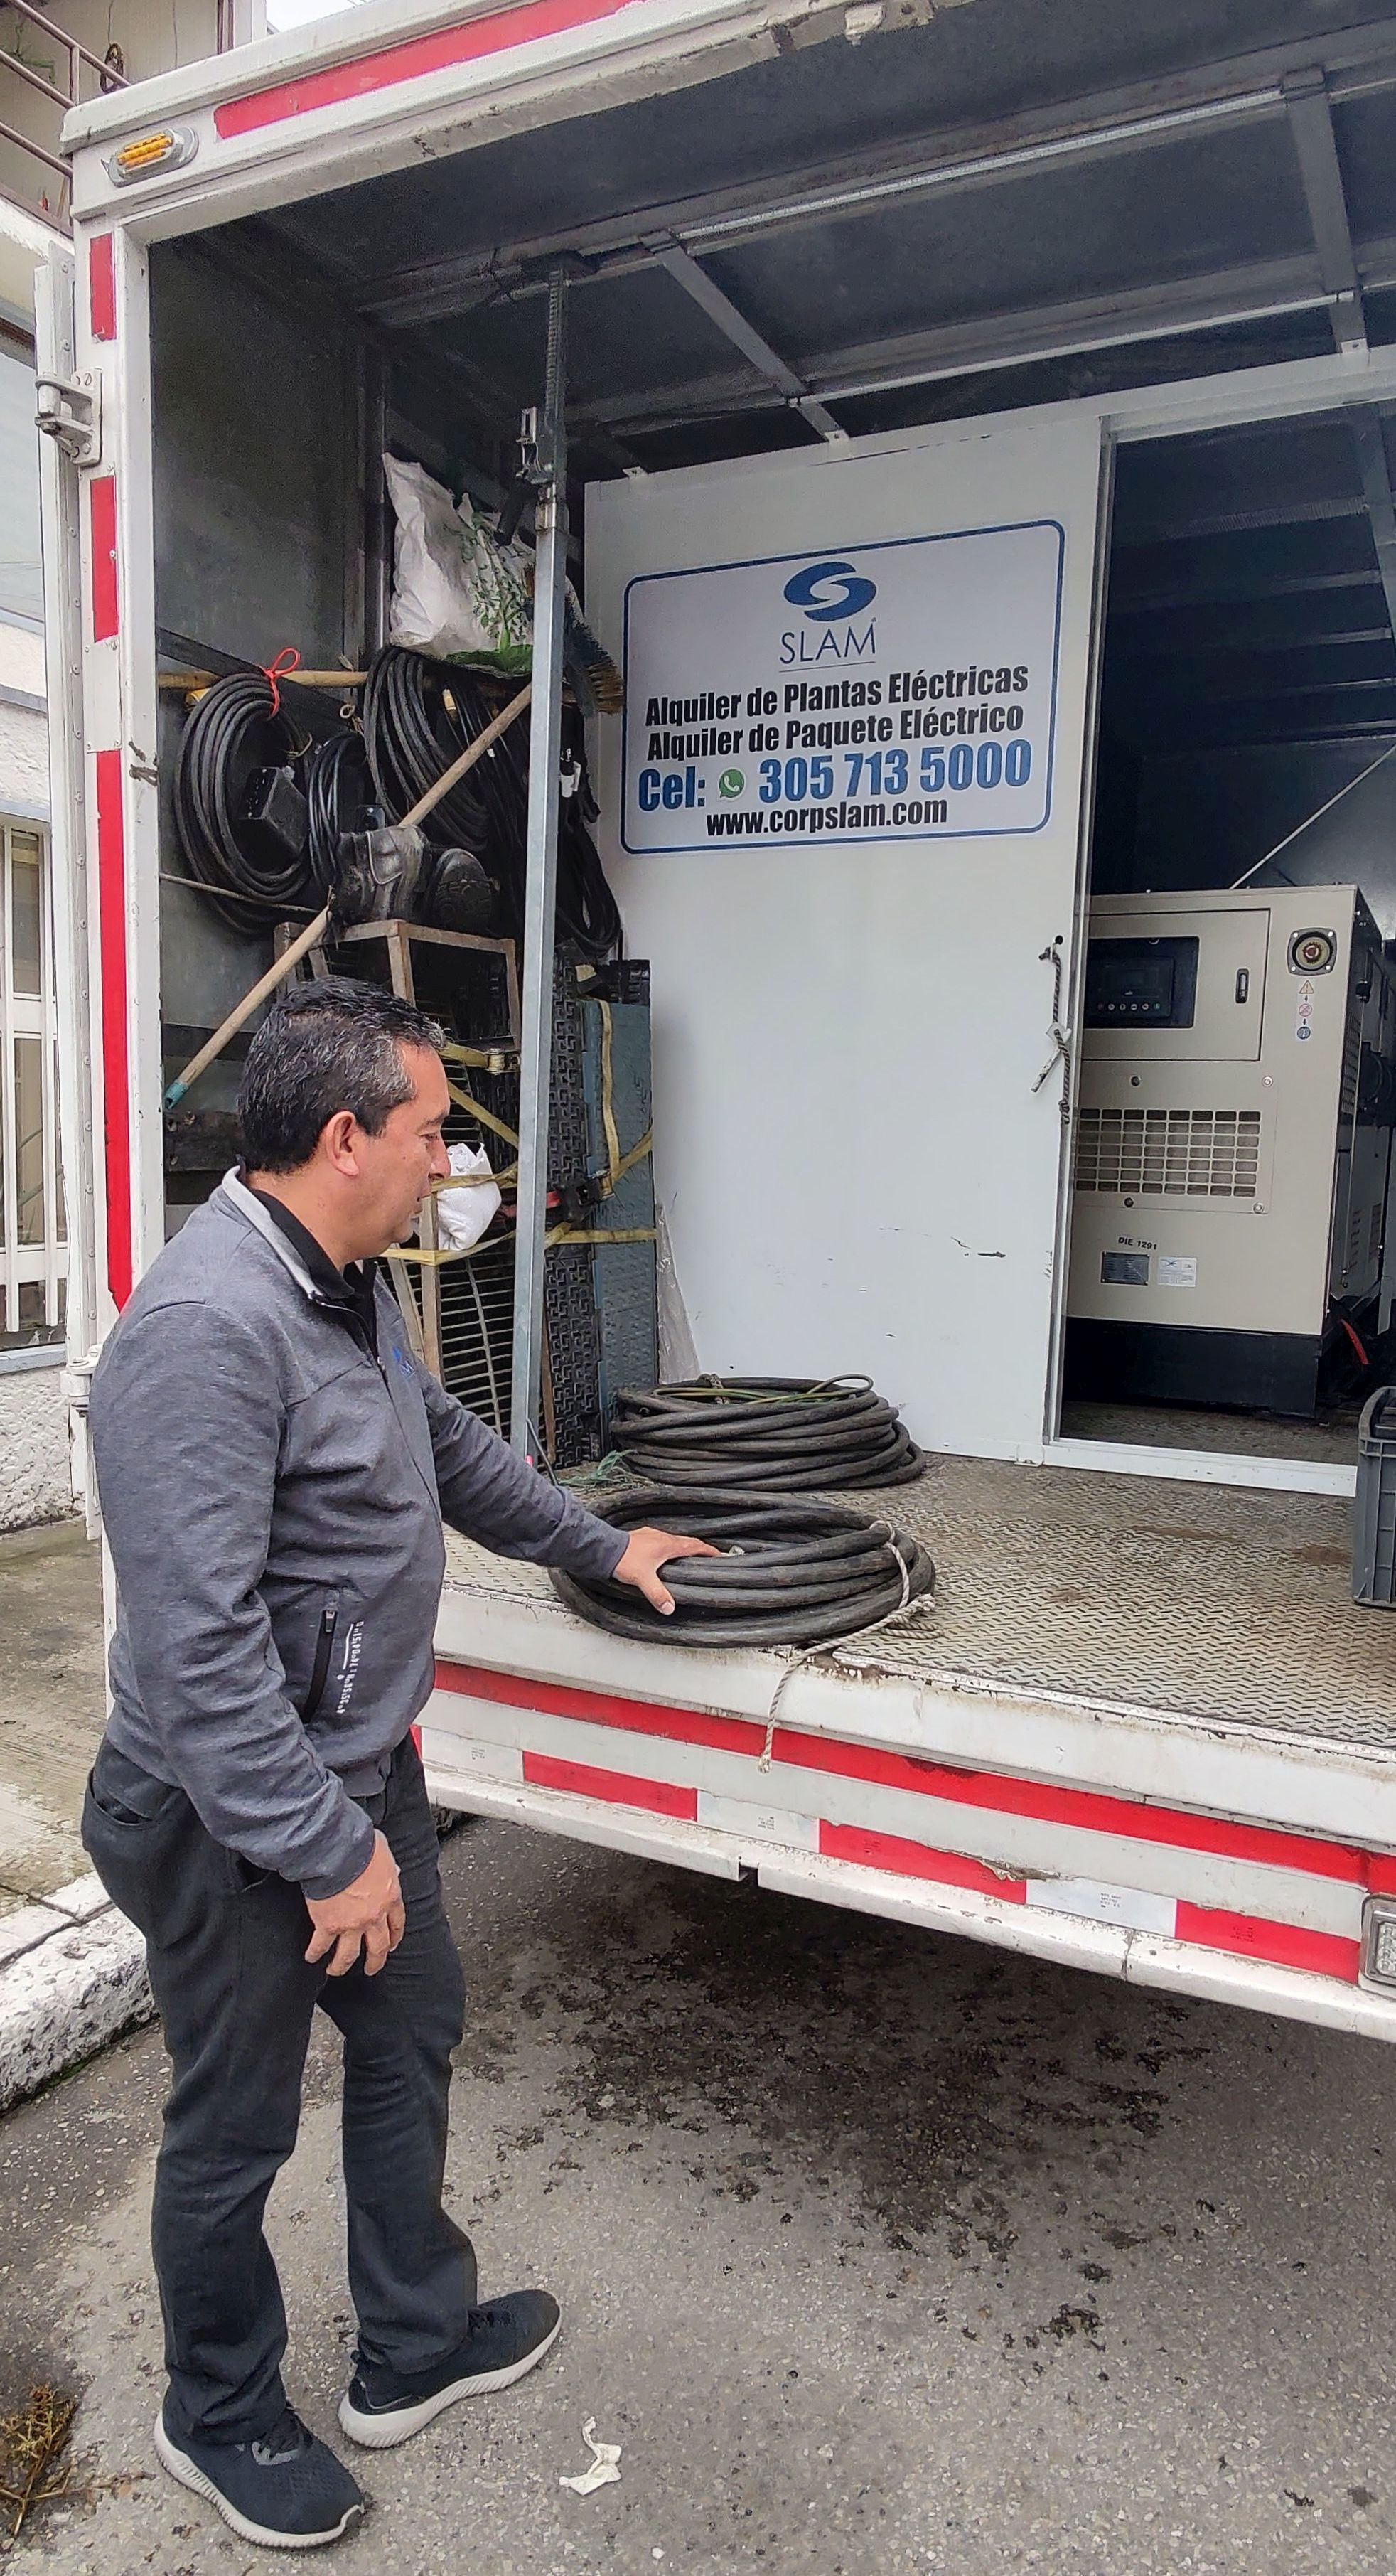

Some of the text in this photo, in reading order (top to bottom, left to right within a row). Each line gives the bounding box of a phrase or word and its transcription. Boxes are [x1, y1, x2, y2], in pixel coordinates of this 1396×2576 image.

[780, 623, 876, 664] SLAM
[645, 666, 1029, 727] Alquiler de Plantas Eléctricas
[647, 702, 1024, 761] Alquiler de Paquete Eléctrico
[638, 739, 1032, 811] Cel: 305 713 5000
[706, 798, 947, 836] www.corpslam.com
[1118, 1236, 1157, 1250] DIE 1291
